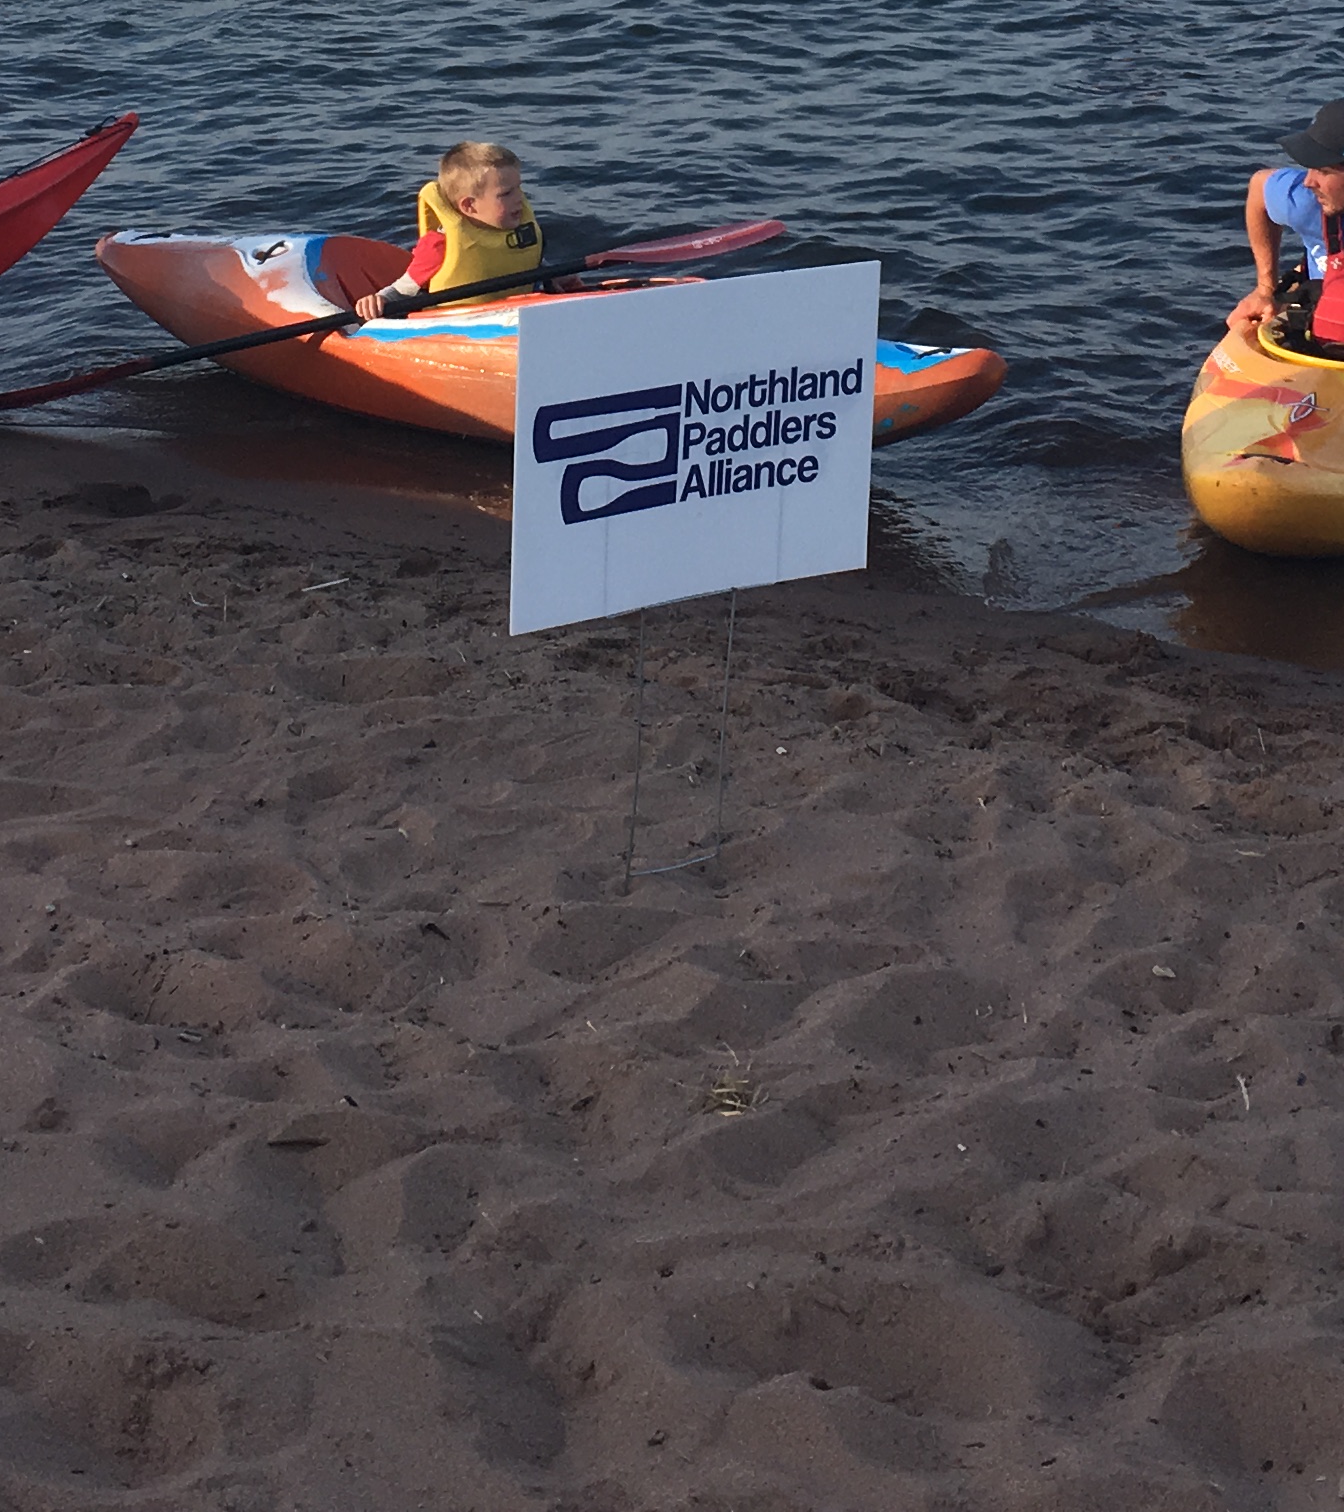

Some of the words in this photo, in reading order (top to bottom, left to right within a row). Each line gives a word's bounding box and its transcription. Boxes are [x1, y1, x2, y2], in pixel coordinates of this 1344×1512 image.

[684, 357, 864, 419] Northland
[682, 409, 837, 461] Paddlers
[679, 454, 819, 503] Alliance
